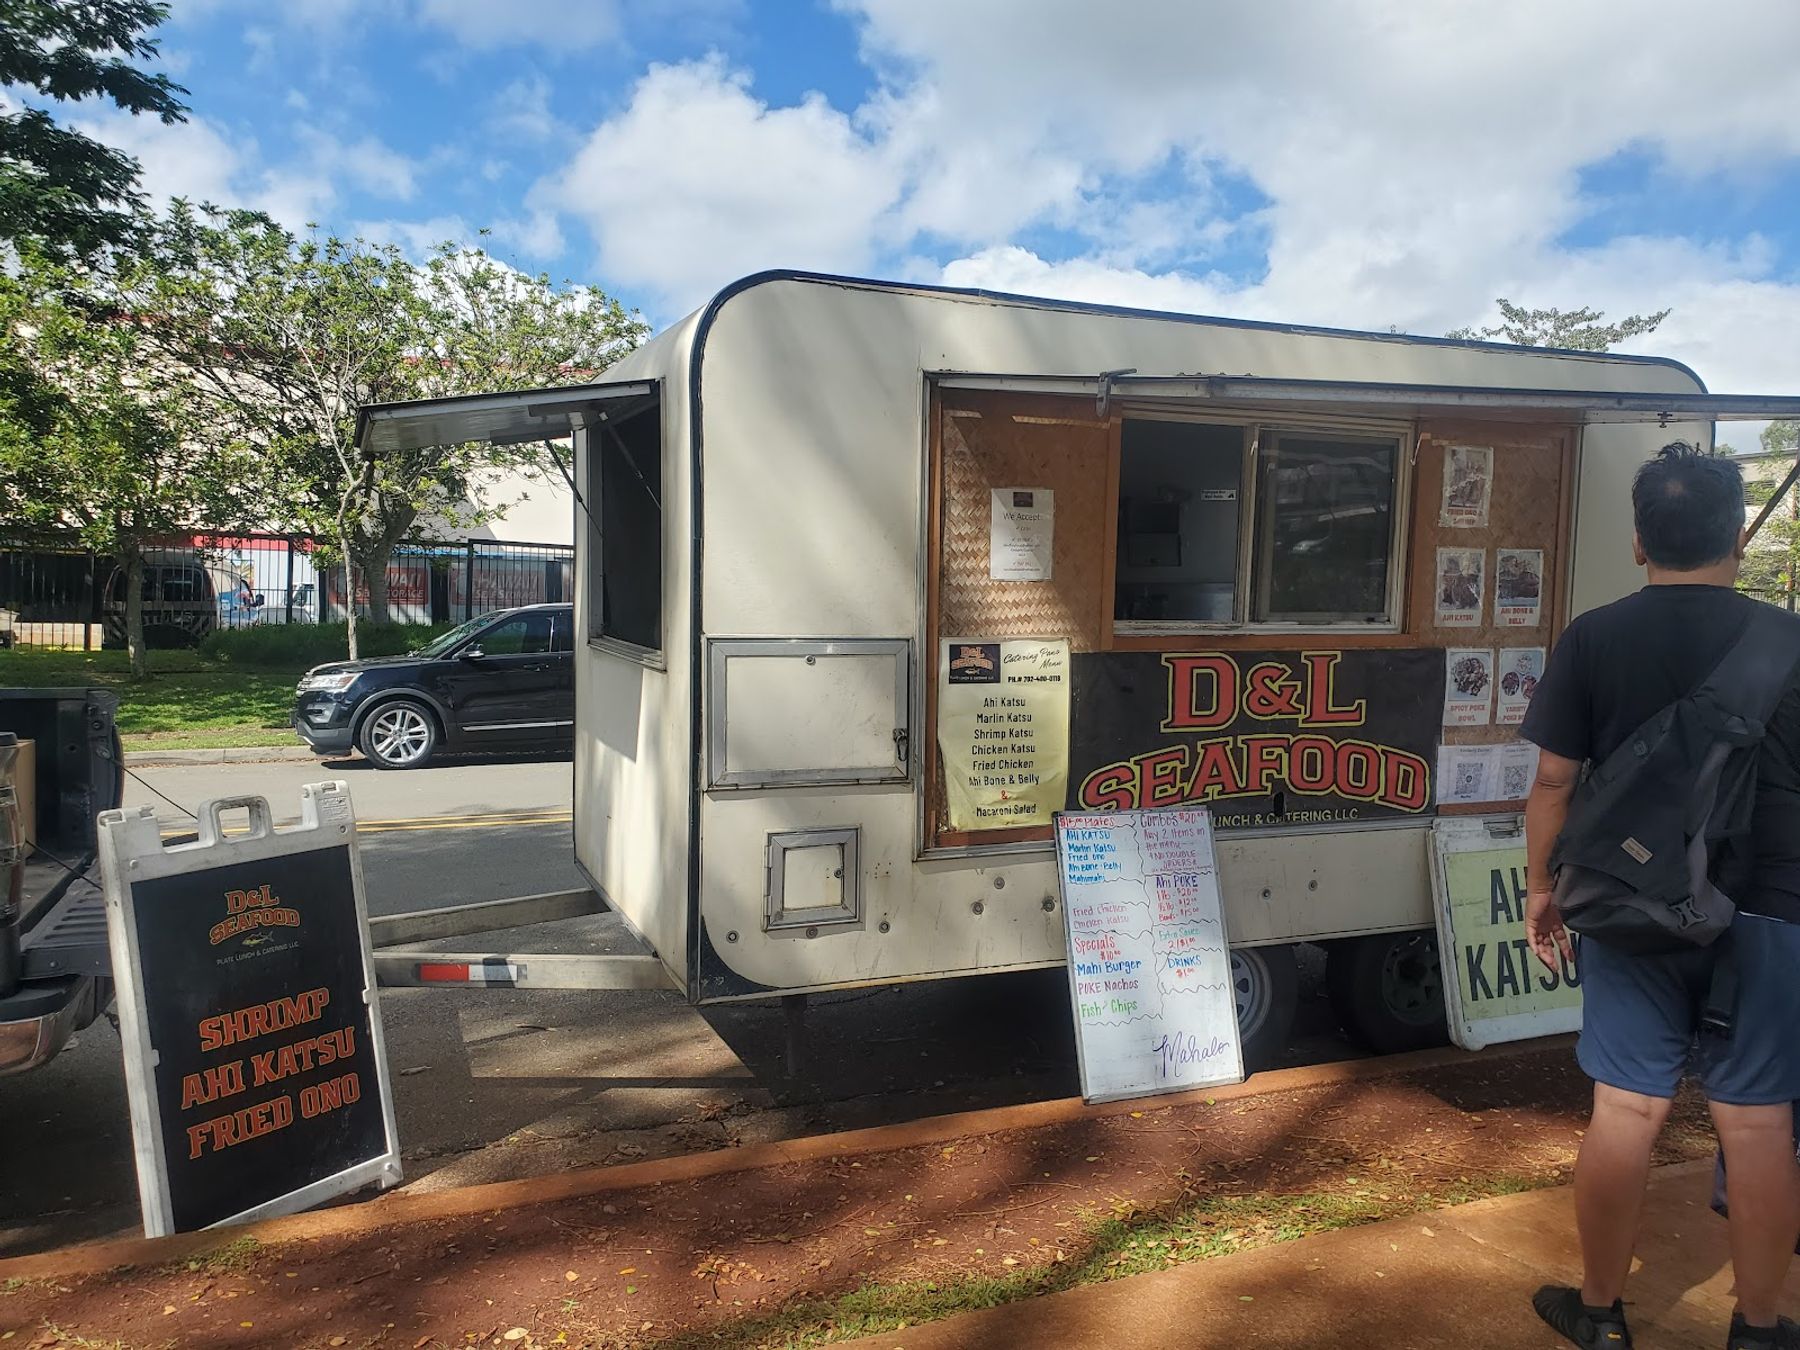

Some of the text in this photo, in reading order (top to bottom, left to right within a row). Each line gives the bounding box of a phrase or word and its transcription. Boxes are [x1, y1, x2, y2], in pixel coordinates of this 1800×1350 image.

[1004, 652, 1039, 664] Catering
[1160, 650, 1367, 733] D&L
[984, 697, 1026, 708] Ahi Katsu
[976, 712, 1032, 724] Marlin Katsu
[974, 728, 1034, 740] Shrimp Katsu
[972, 744, 1036, 755] Chicken Katsu
[972, 759, 1034, 770] Fried Chicken
[968, 774, 1040, 786] Ahi Bone & Belly
[1078, 733, 1431, 814] SEAFOOD
[1001, 790, 1008, 800] &
[1014, 804, 1036, 814] Salad
[1212, 815, 1250, 828] UNCH
[1254, 814, 1263, 825] &
[1334, 808, 1358, 820] LLC
[1066, 829, 1110, 841] AHI KATSU
[1162, 828, 1168, 839] 2
[1068, 853, 1088, 862] Fried
[1156, 875, 1198, 888] Ahi POKE
[224, 885, 280, 915] D&L
[1490, 866, 1528, 925] AH
[1073, 906, 1094, 917] Fried
[210, 908, 300, 945] SEAFOOD
[1074, 934, 1115, 956] Specials
[1076, 960, 1142, 976] Mahi Burger
[1168, 954, 1202, 968] DRINKS
[1078, 978, 1139, 996] POKE Nachos
[1080, 999, 1138, 1018] Fish Chips
[200, 986, 330, 1052] SHRIMP
[1152, 1031, 1230, 1078] Mahalo
[181, 1026, 356, 1111] AHI KATSU
[187, 1072, 360, 1160] FRIED ONO
